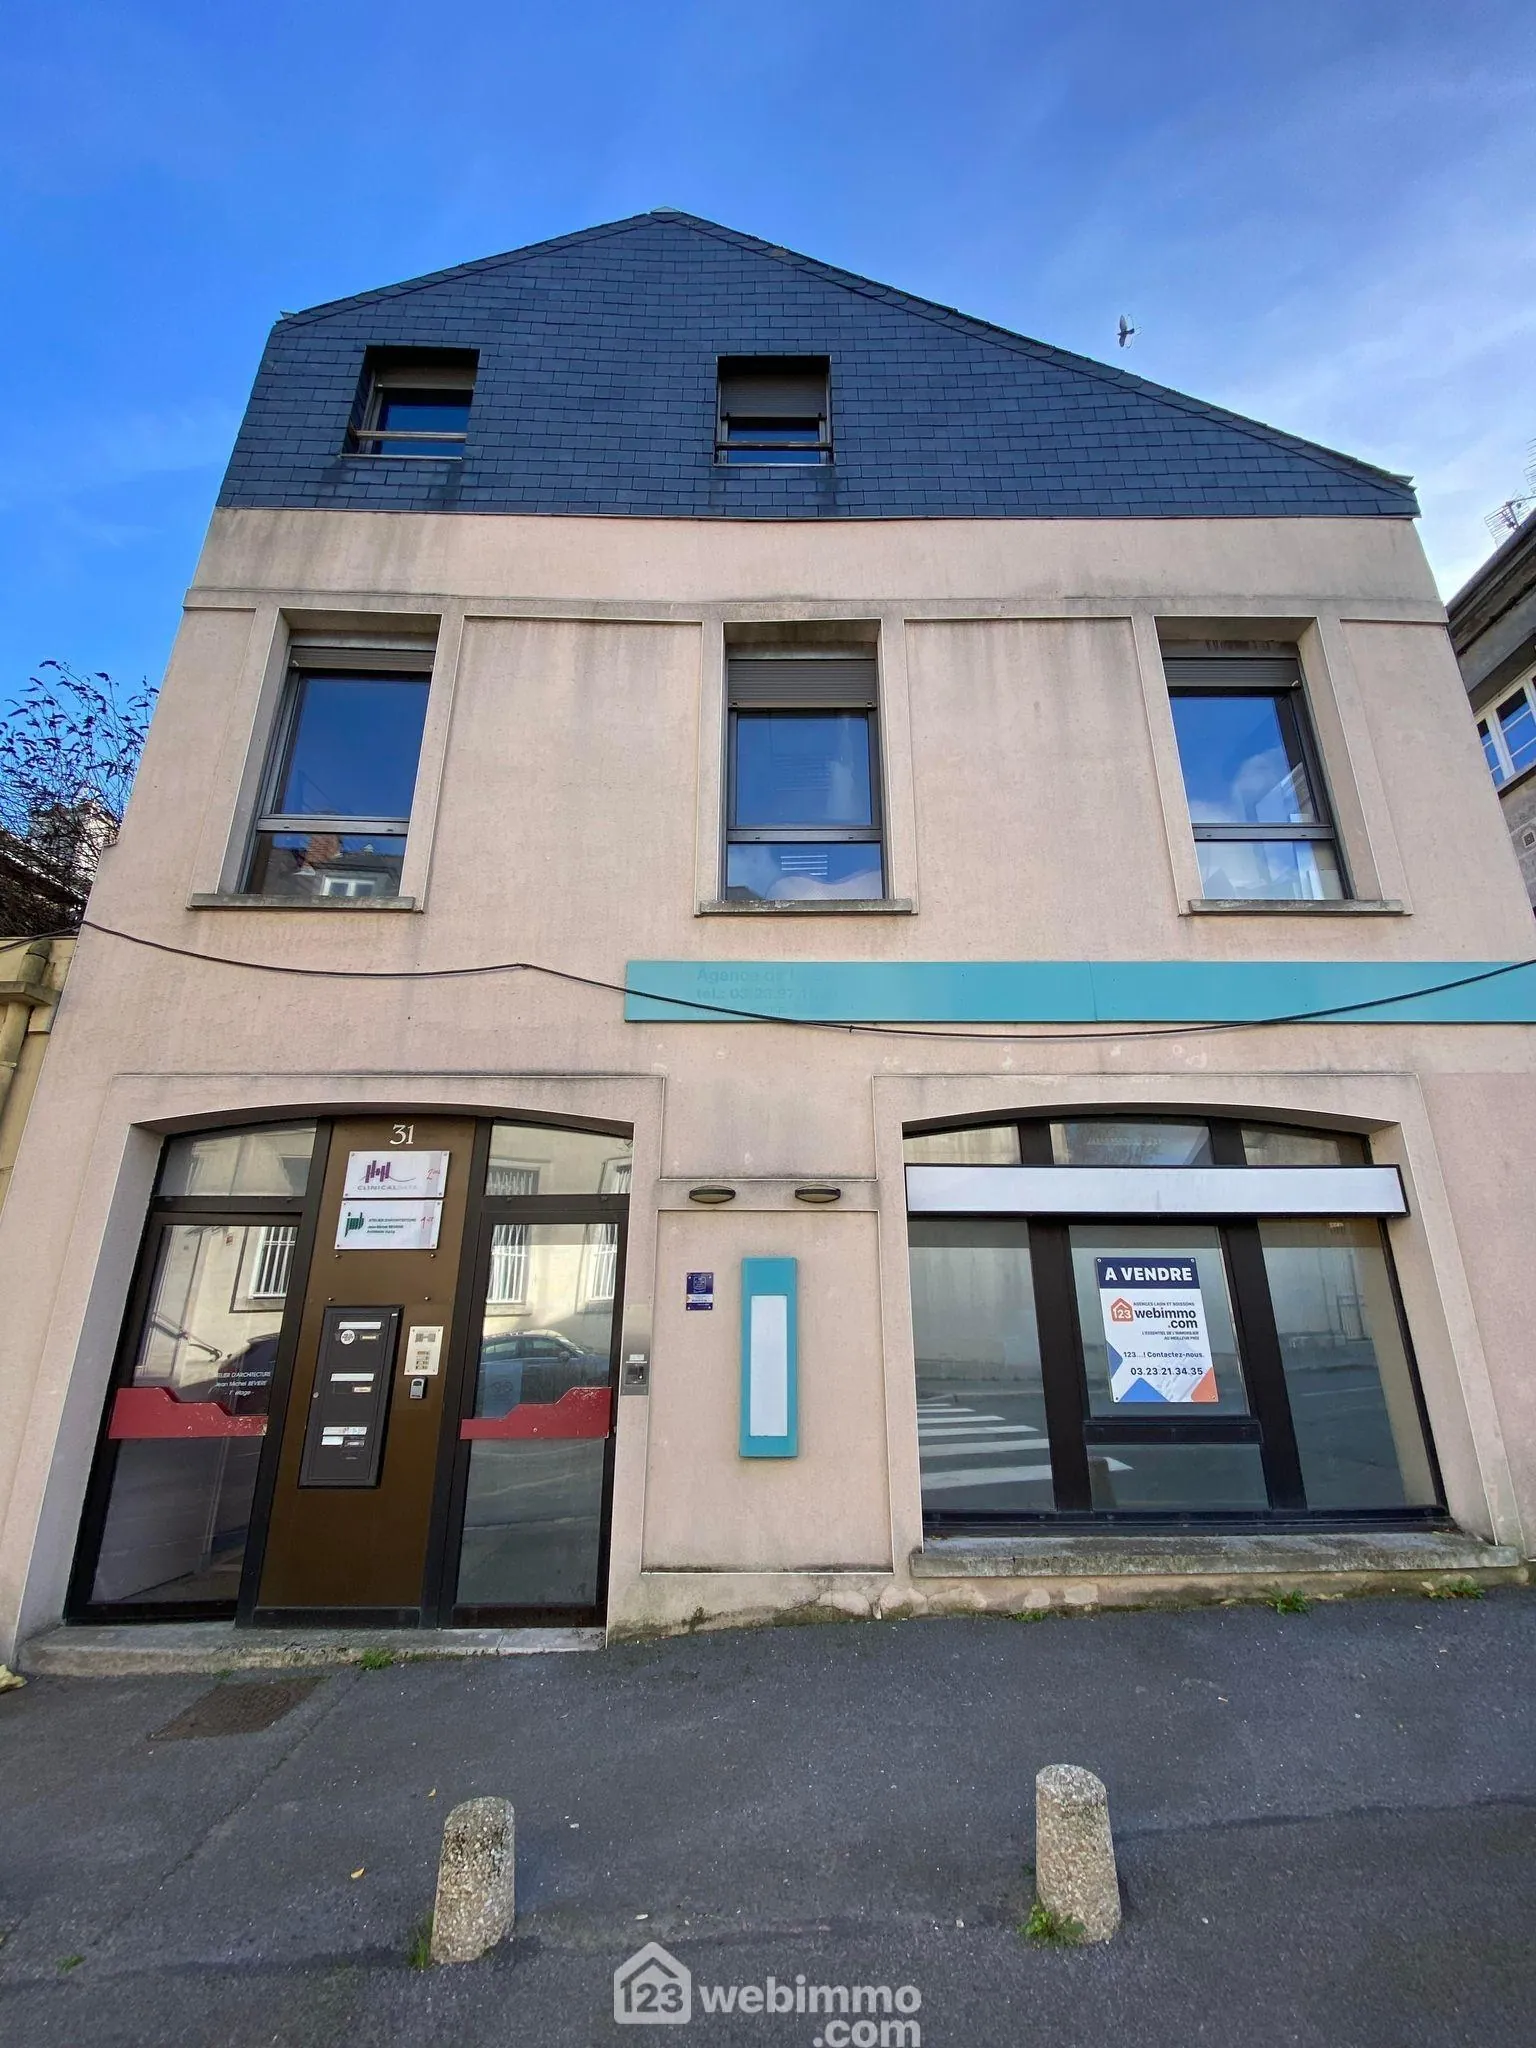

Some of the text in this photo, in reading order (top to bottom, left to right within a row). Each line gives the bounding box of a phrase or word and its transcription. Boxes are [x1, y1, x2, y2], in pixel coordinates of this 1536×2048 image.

[389, 1124, 414, 1145] 31
[1105, 1267, 1193, 1281] A VENDRE
[1112, 1307, 1197, 1319] 123 webimmo
[1168, 1319, 1198, 1329] .com
[1130, 1367, 1204, 1376] 03.23.21.34.35
